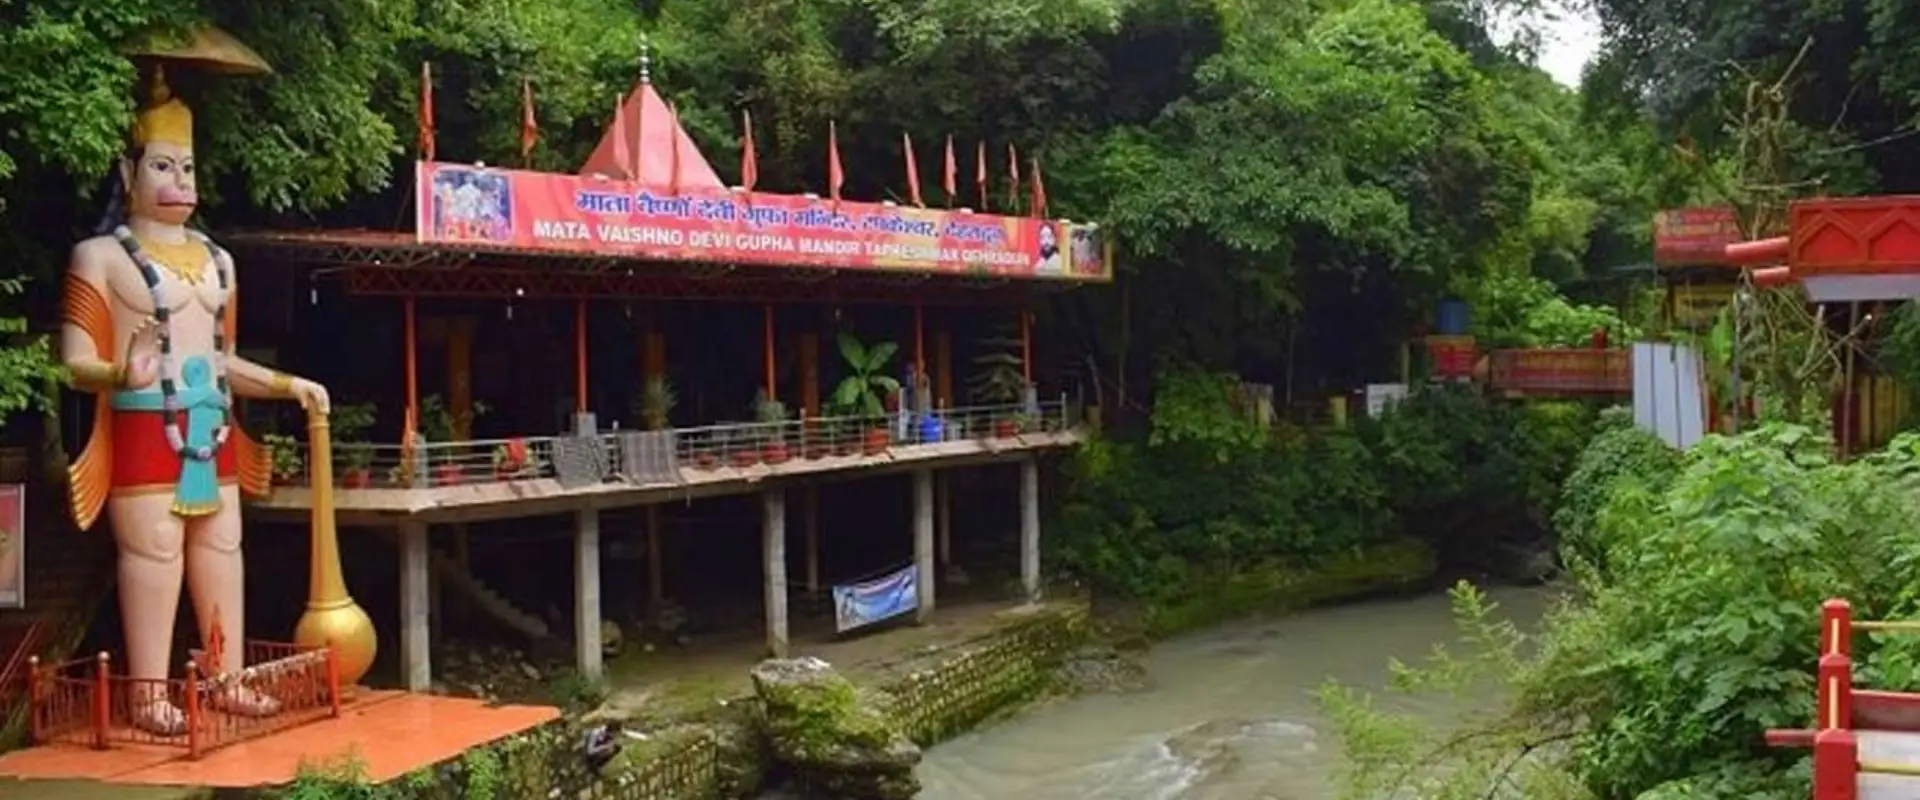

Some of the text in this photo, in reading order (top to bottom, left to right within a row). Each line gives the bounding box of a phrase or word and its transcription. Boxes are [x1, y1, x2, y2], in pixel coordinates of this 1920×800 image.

[533, 219, 591, 240] MATA
[597, 223, 683, 246] VAISHNO
[689, 230, 731, 249] DEVI
[736, 235, 795, 252] GUPHA
